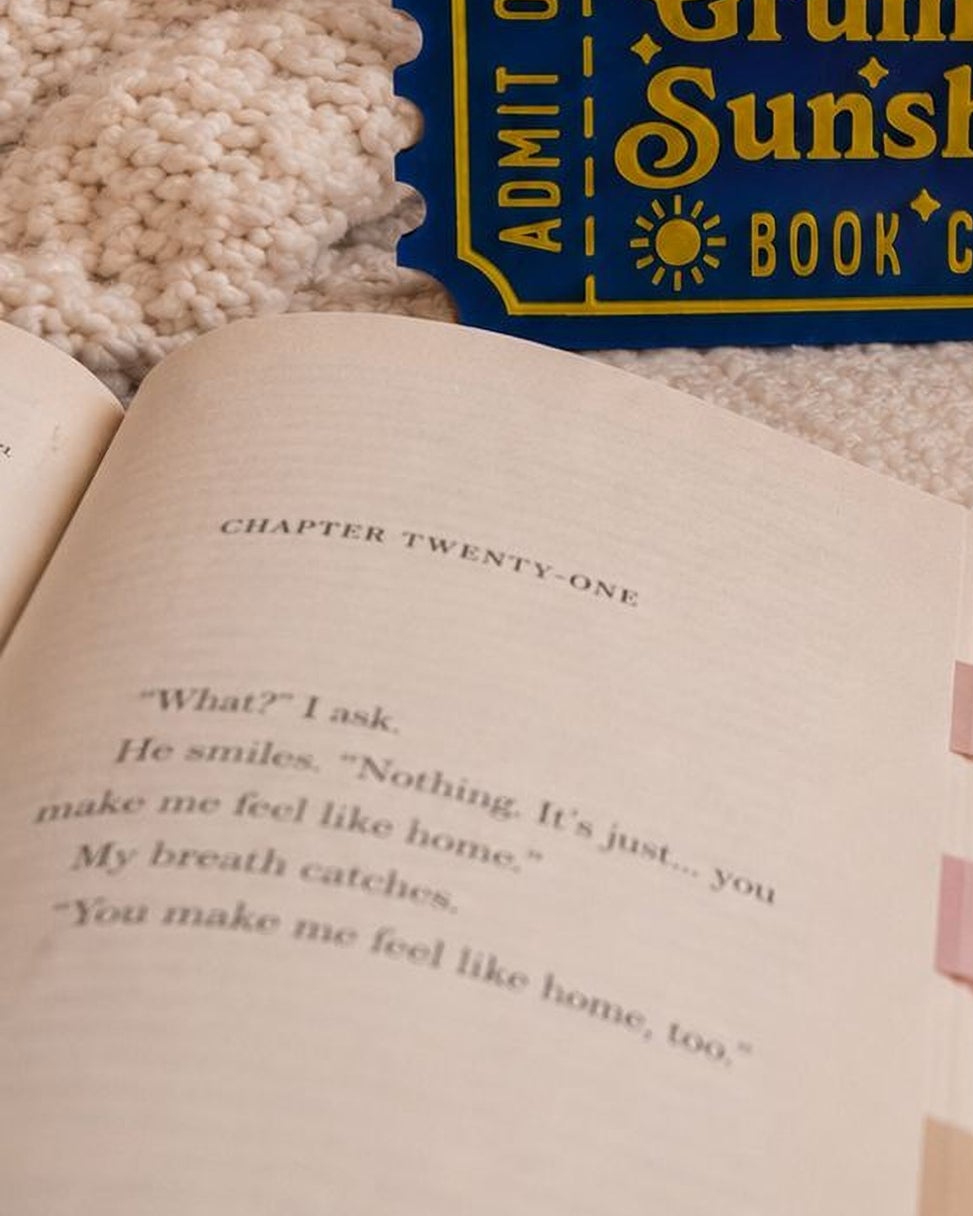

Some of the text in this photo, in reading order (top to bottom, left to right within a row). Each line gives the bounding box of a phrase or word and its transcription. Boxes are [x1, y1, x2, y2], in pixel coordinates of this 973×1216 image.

[495, 68, 563, 252] ADMIT
[752, 210, 903, 278] BOOK
[220, 518, 640, 608] CHAPTER TWENTY-ONE
[139, 687, 400, 735] "What?" I ask.
[33, 789, 544, 874] make me feel like home."
[114, 737, 776, 905] He smiles. "Nothing. It's just... you
[70, 840, 459, 914] My breath catches.
[162, 902, 282, 935] make
[292, 918, 359, 947] me
[368, 924, 446, 970] feel
[455, 944, 531, 992] like
[540, 971, 654, 1041] home,
